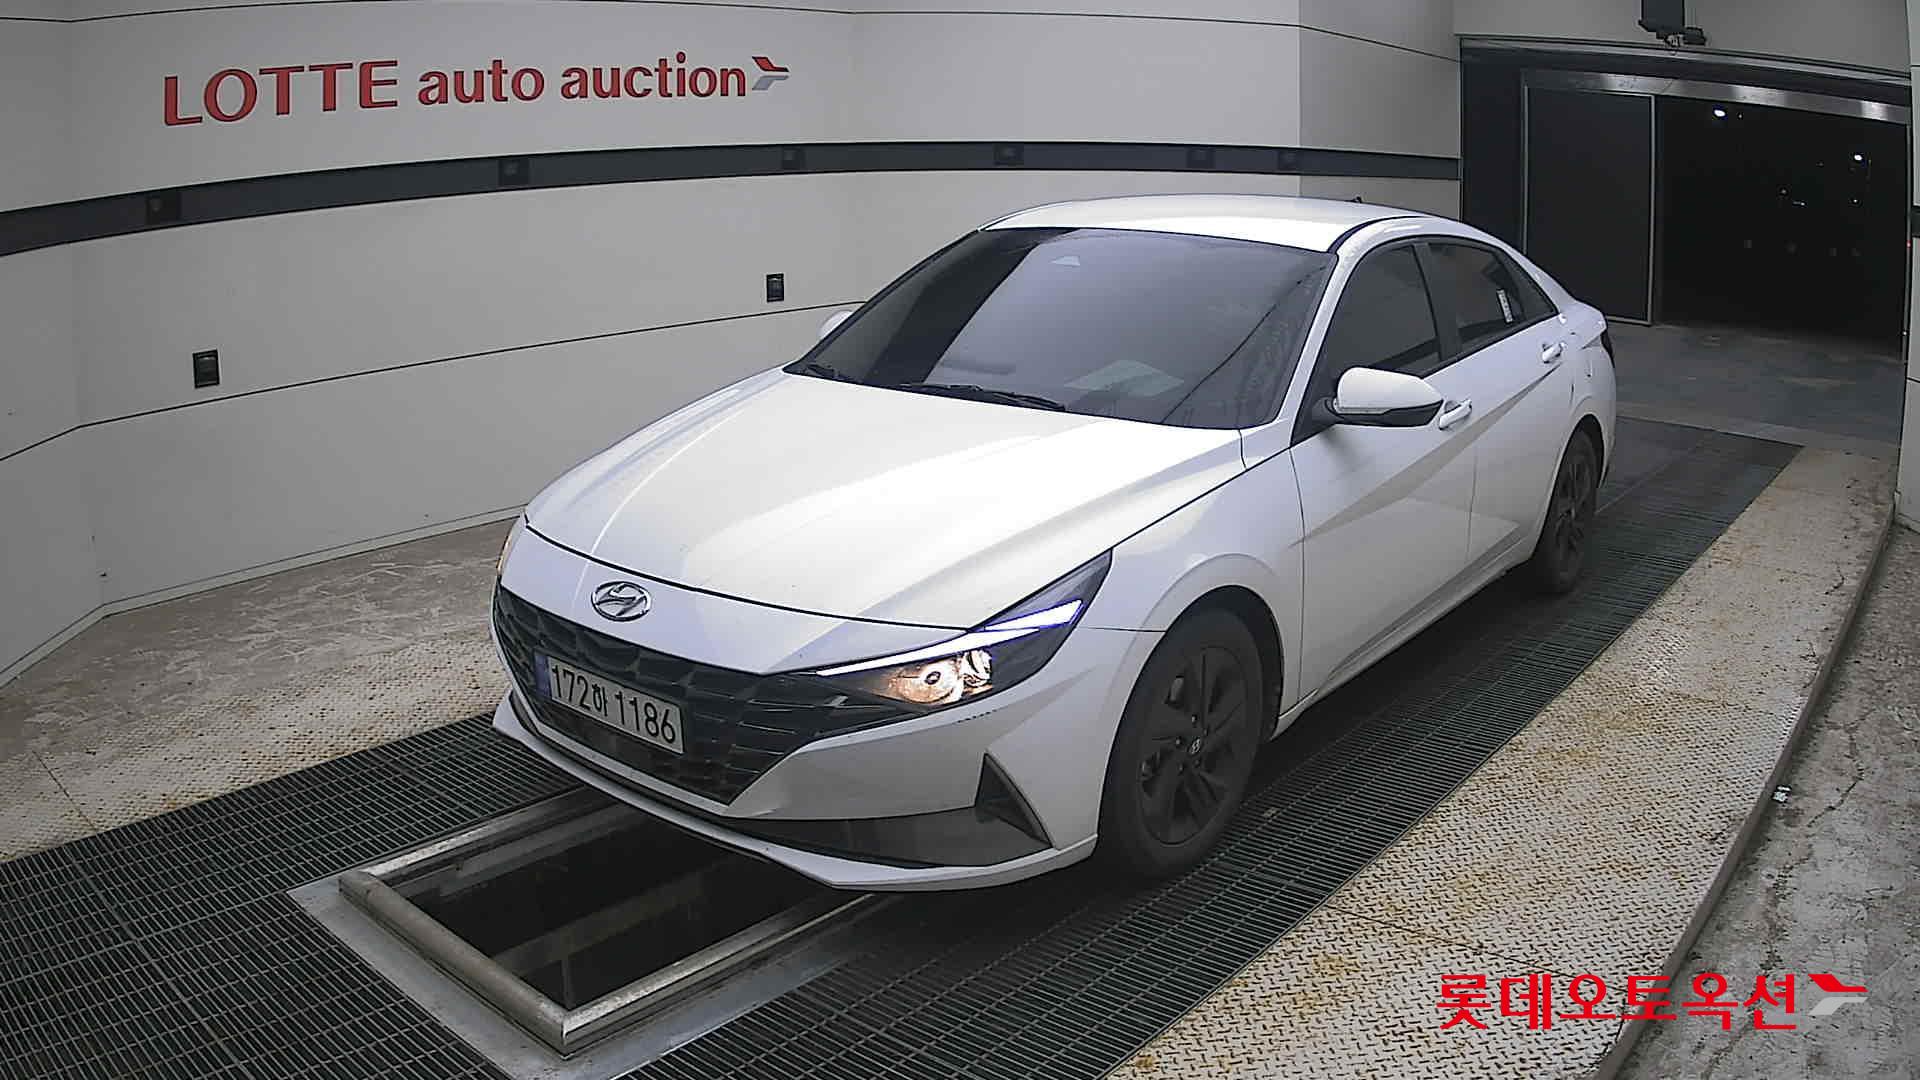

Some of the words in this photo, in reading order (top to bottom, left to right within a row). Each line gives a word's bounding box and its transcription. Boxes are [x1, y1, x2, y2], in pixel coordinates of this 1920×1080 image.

[163, 60, 399, 125] LOTTE
[416, 59, 545, 106] auto
[560, 51, 748, 99] auction
[552, 664, 609, 717] 172하
[614, 690, 677, 744] 1186
